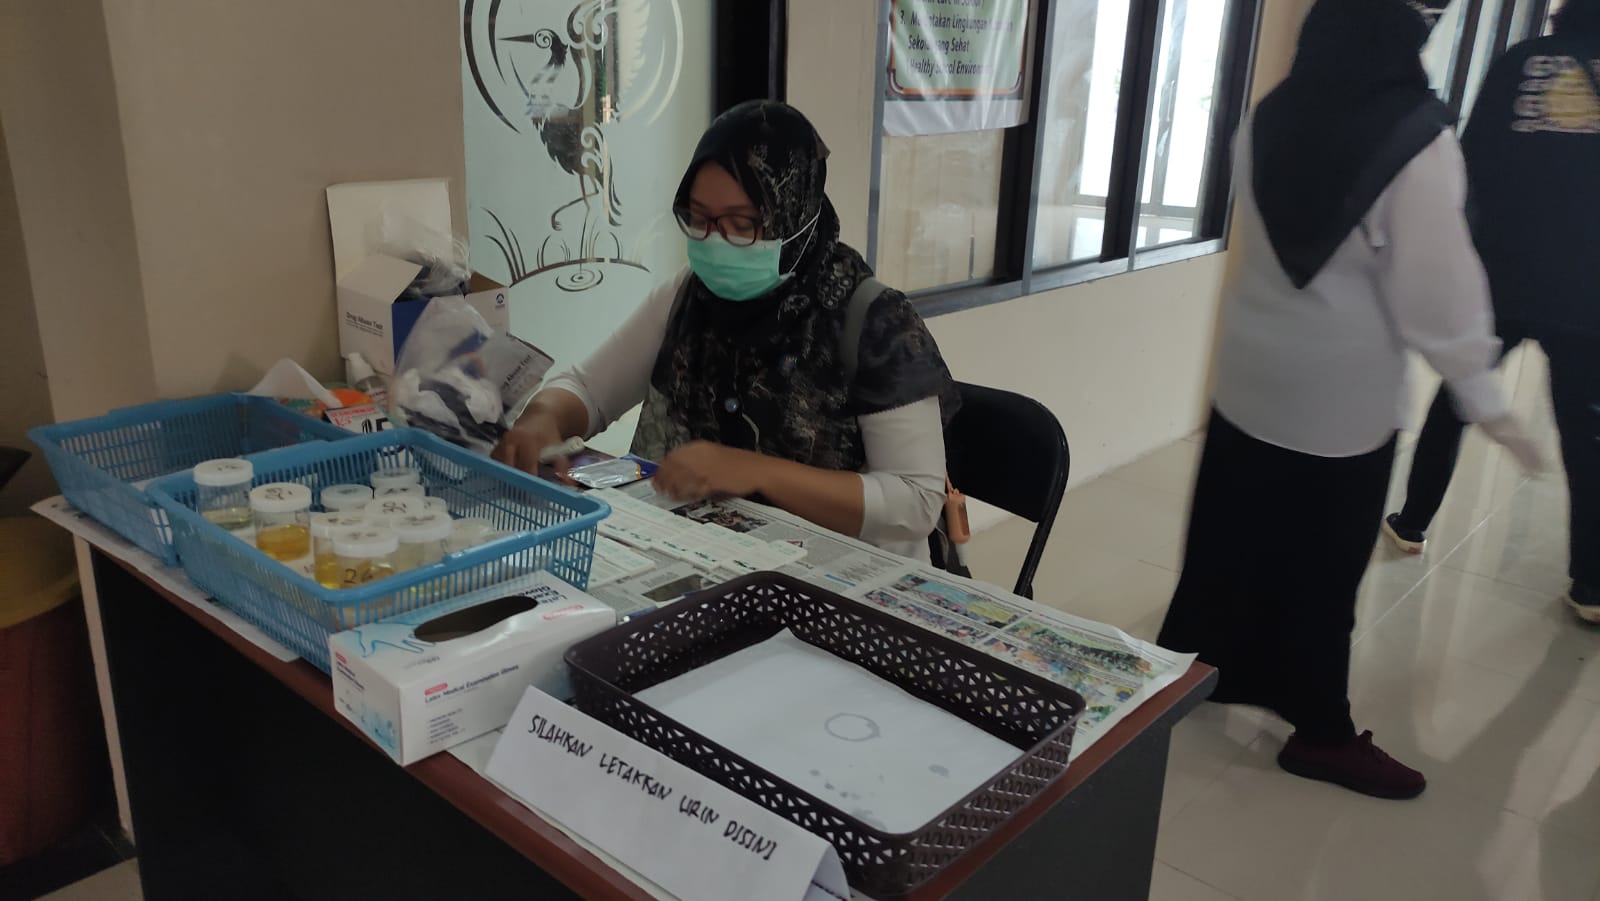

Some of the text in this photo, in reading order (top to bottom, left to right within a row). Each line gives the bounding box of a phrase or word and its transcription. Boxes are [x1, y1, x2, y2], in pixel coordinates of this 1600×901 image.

[950, 37, 970, 53] Sehat
[528, 714, 594, 758] SILAHKAN
[679, 795, 720, 825] URIN
[723, 820, 778, 861] DISINI
